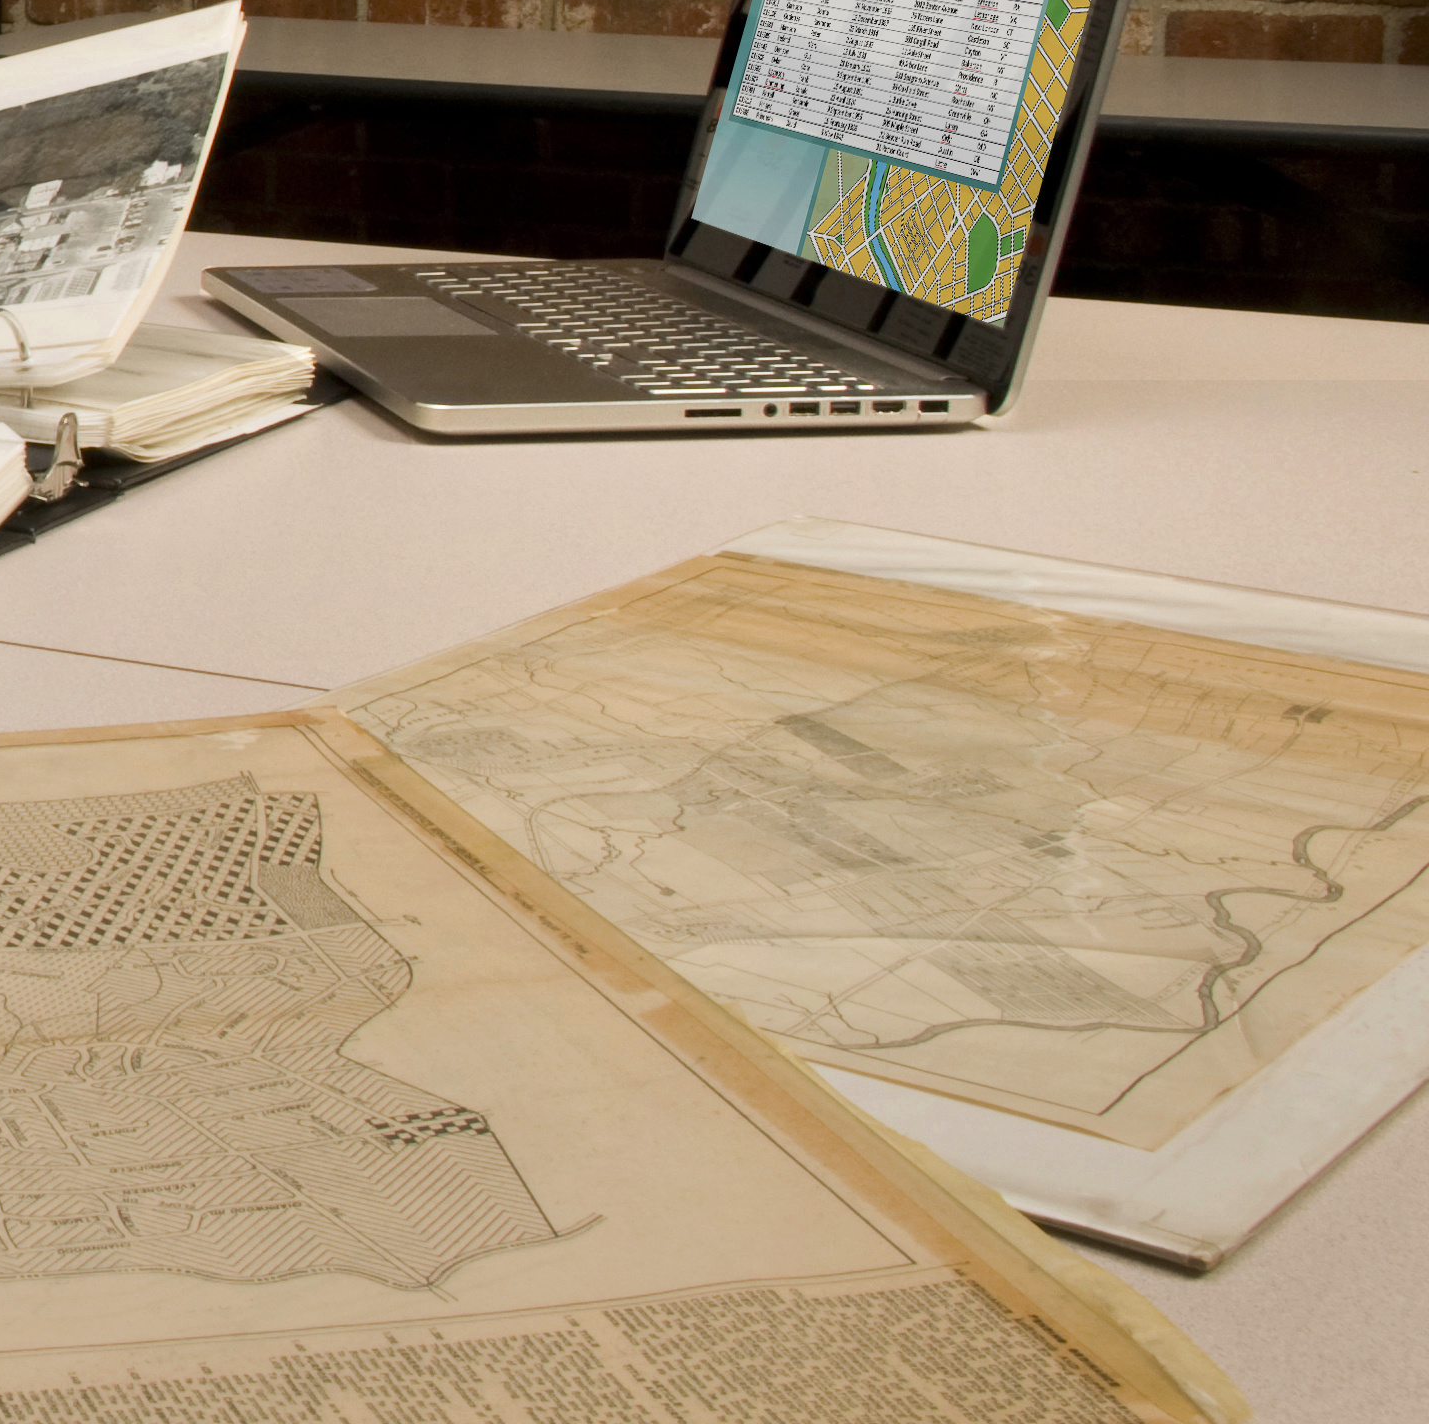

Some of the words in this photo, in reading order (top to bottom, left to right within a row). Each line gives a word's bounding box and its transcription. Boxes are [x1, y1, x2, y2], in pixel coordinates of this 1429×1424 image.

[121, 1182, 197, 1196] EVERGREEN
[230, 1202, 303, 1216] CHARNWOOD
[51, 1214, 102, 1227] ELMORE
[56, 1242, 132, 1255] CHARNWOOD
